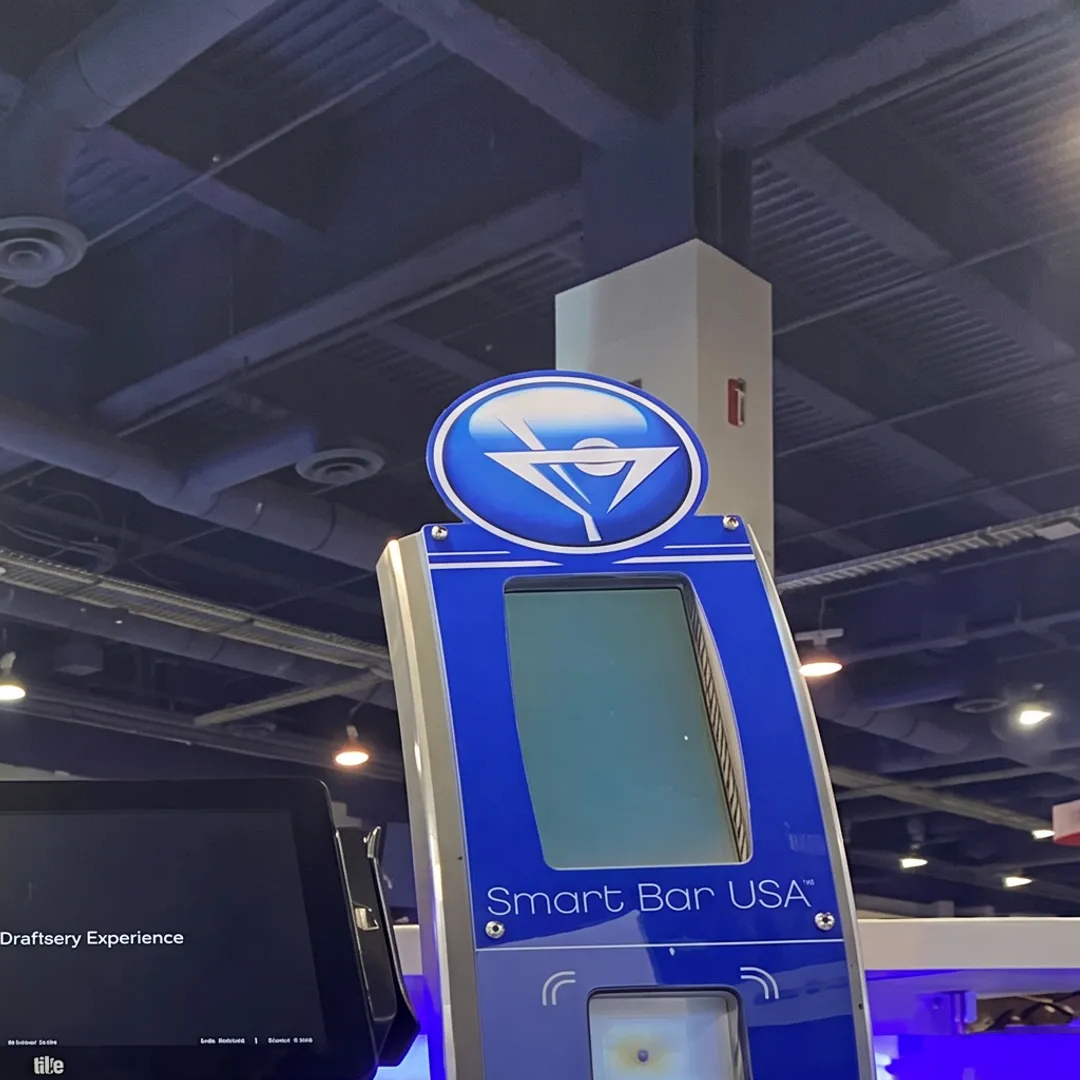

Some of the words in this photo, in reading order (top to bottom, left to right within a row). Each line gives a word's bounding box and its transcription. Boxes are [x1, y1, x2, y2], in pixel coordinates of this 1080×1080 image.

[487, 885, 625, 916] Smart
[637, 882, 715, 912] Bar
[0, 930, 82, 949] Draftsery
[86, 930, 185, 948] Experience
